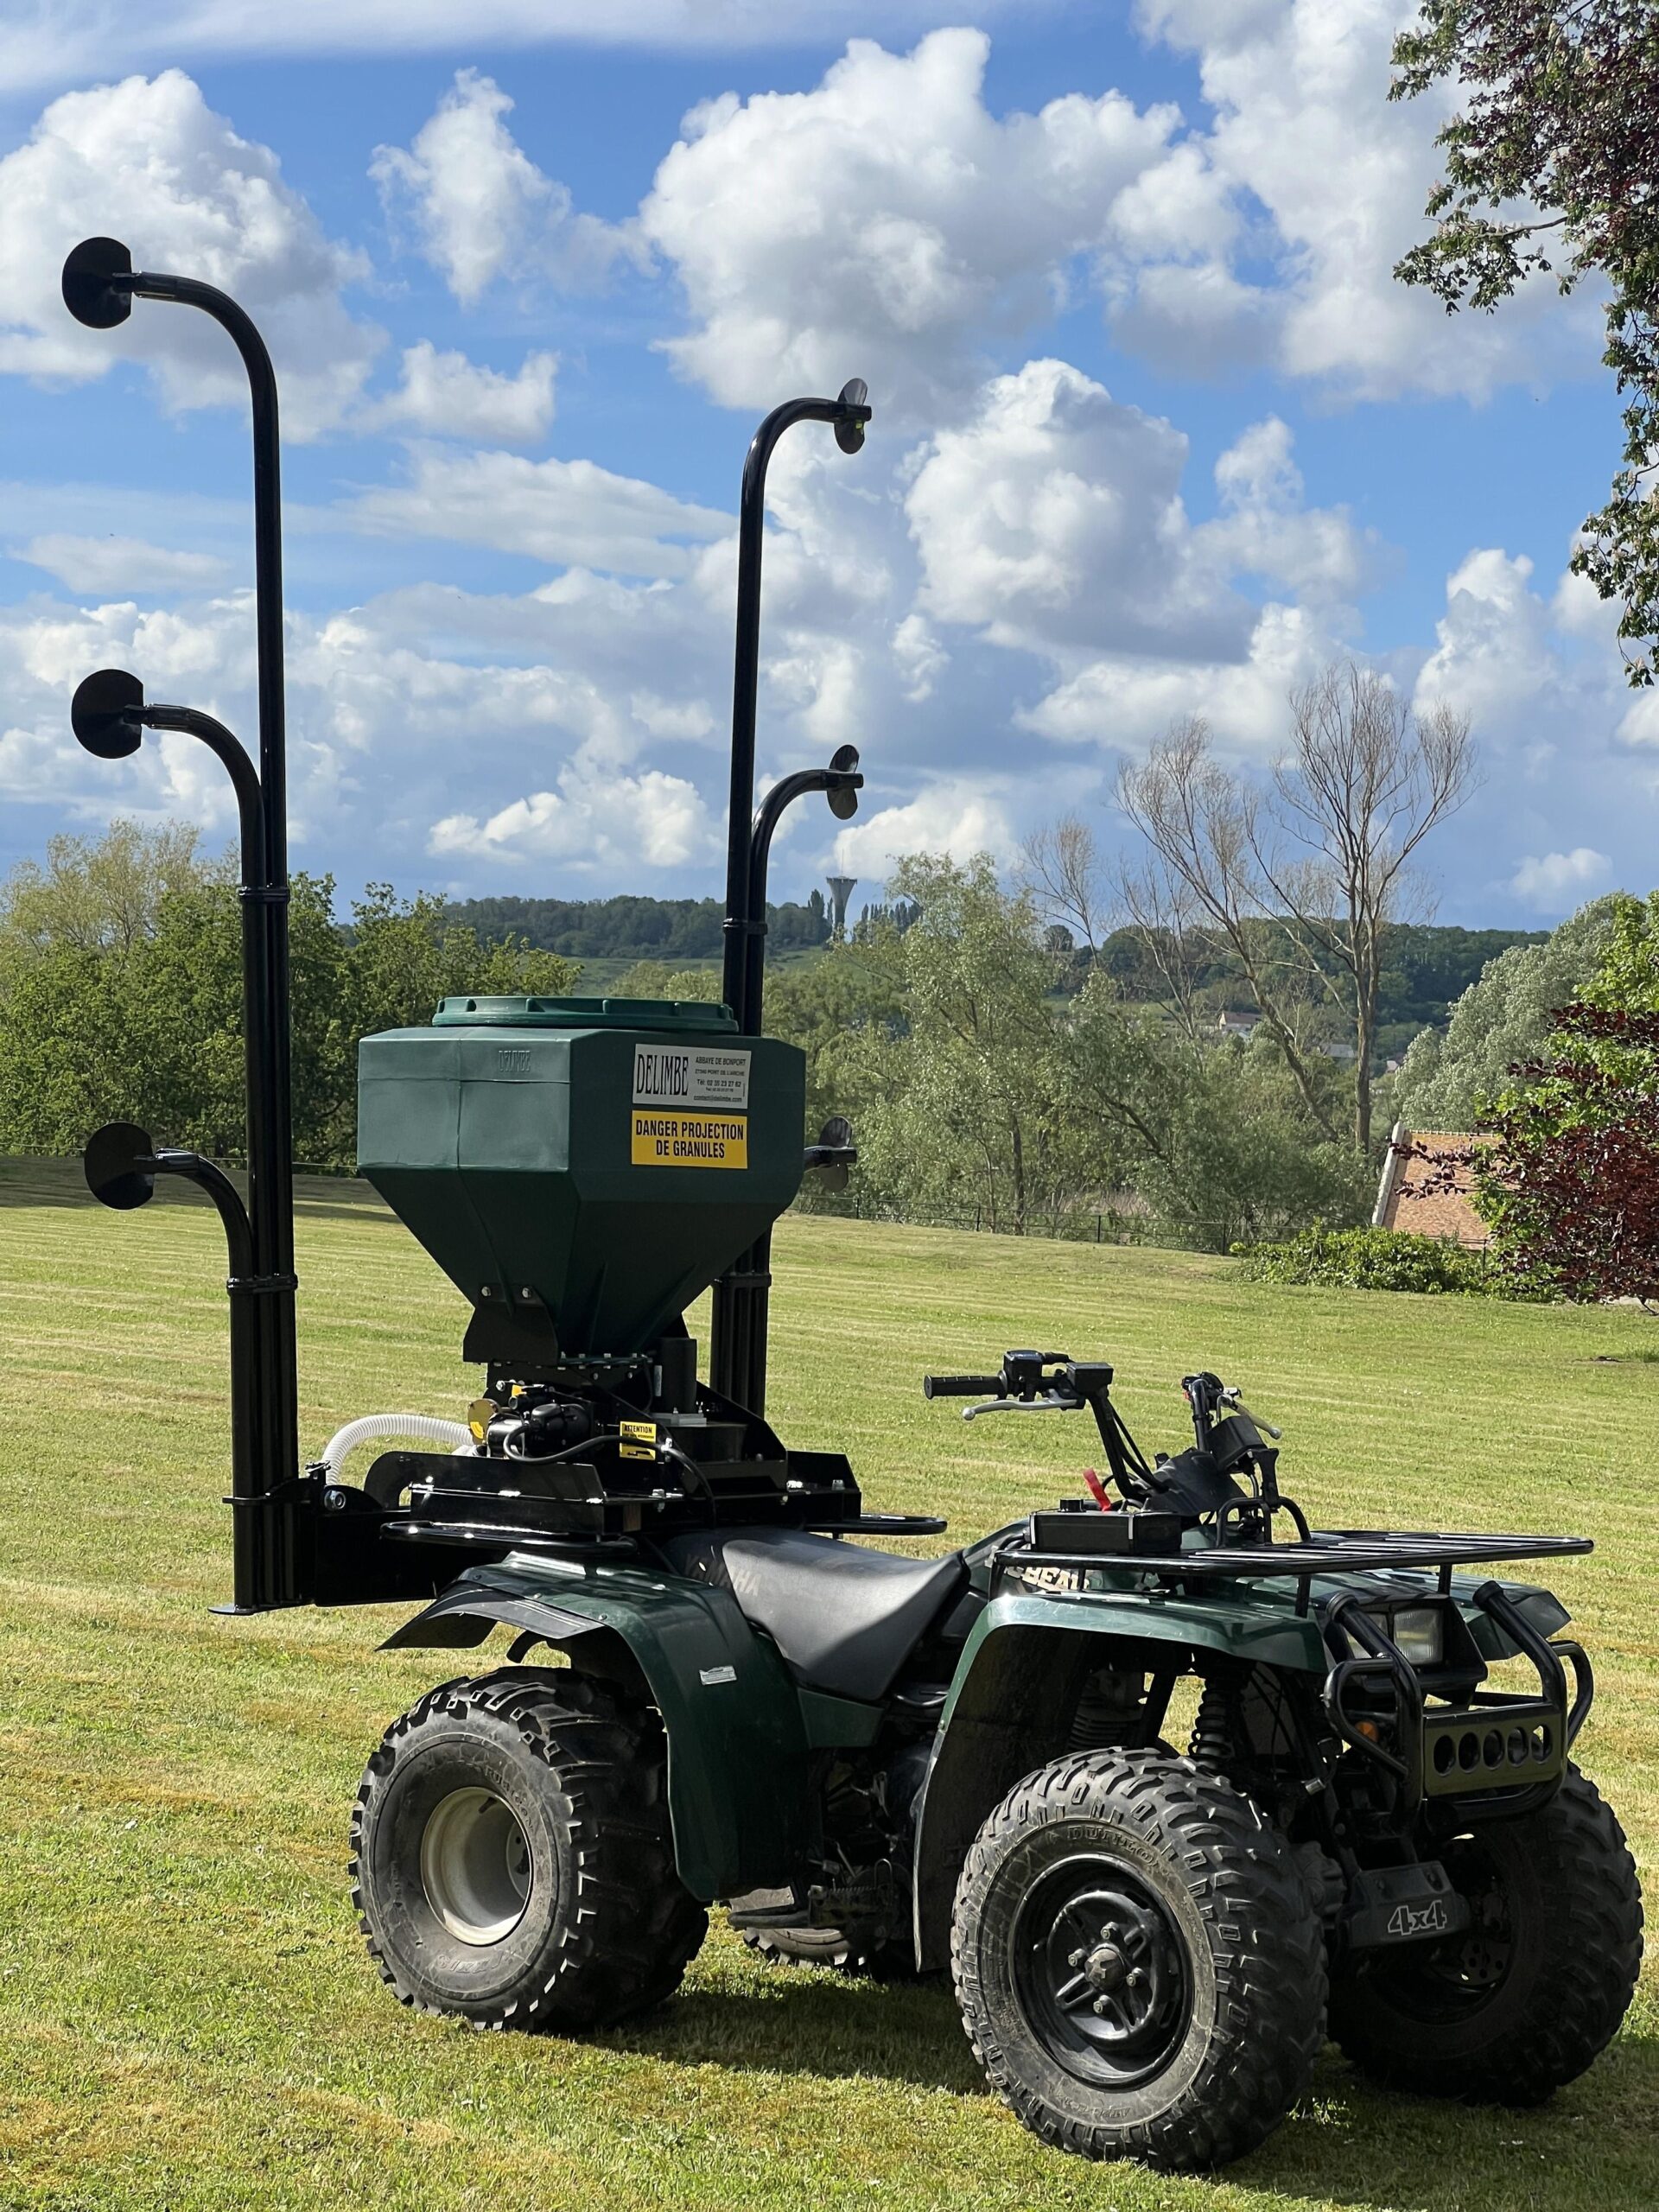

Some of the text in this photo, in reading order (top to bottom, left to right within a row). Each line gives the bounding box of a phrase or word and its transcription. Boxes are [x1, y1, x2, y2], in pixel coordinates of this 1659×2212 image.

[696, 1056, 715, 1065] ABBAYE
[723, 1058, 746, 1066] BONPORT
[637, 1053, 689, 1096] DELIMBE
[636, 1119, 744, 1140] DANGER PROJECTION
[656, 1140, 725, 1159] DE GRANULES
[624, 1425, 652, 1433] ATTENTION
[1388, 1899, 1447, 1936] 4x4
